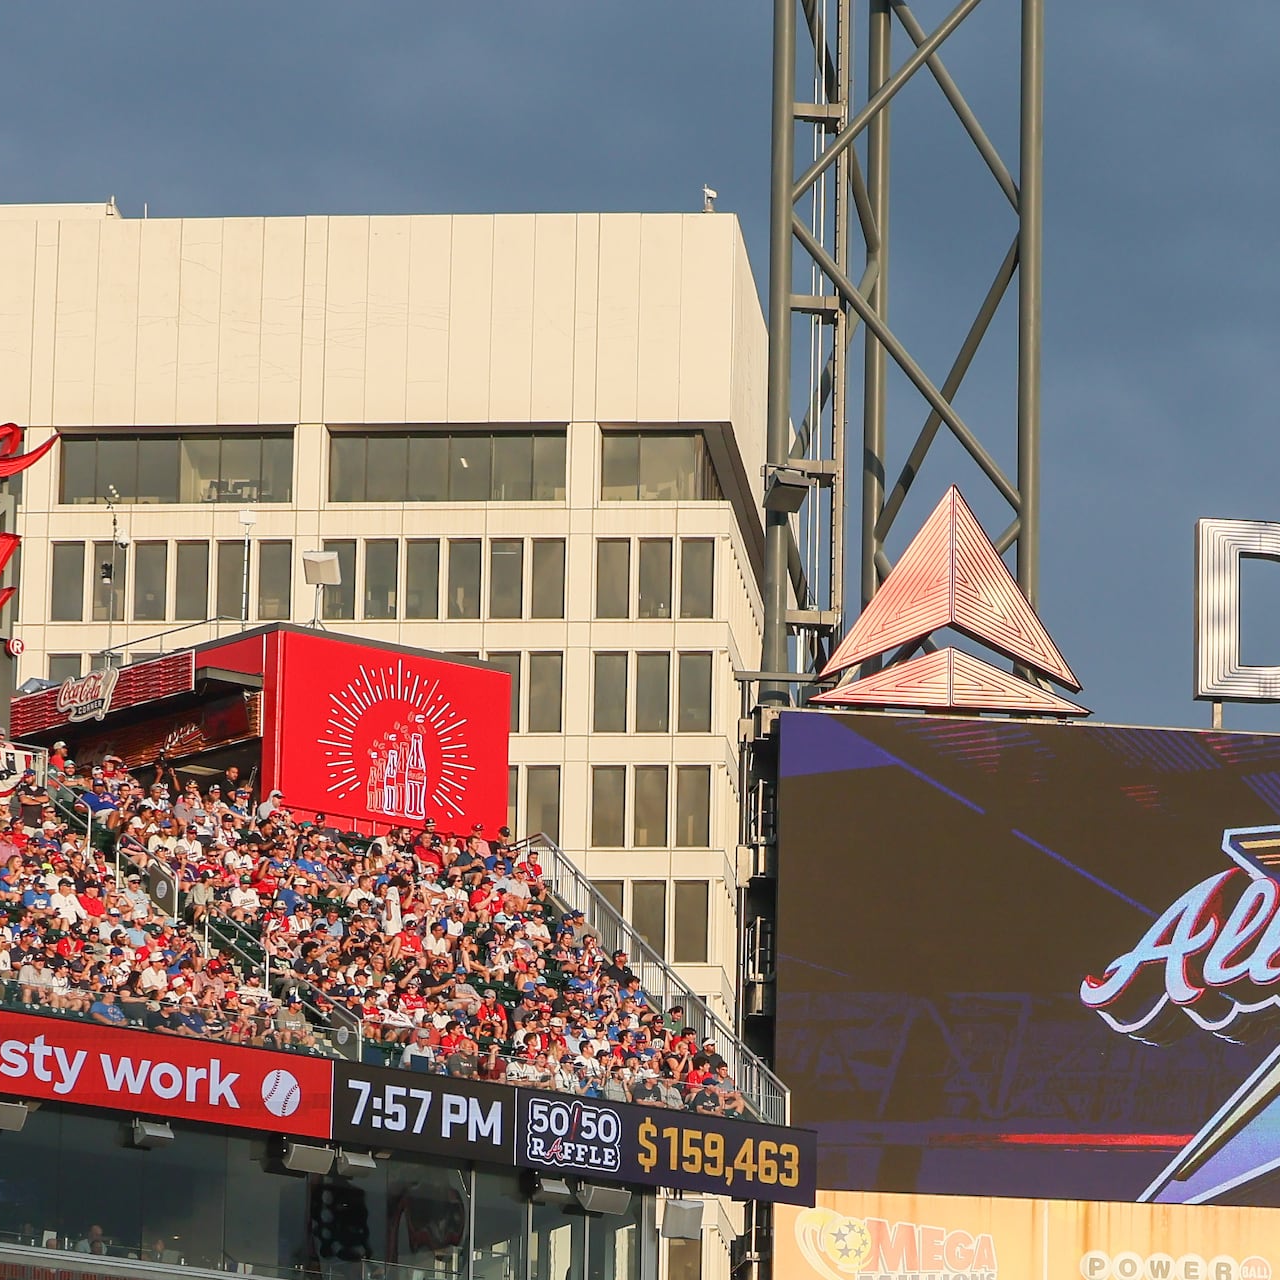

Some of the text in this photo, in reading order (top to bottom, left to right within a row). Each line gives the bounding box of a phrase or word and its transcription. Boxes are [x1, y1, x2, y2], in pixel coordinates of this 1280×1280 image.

[77, 699, 103, 715] CORNER
[100, 1053, 241, 1110] work
[348, 1080, 503, 1146] 7:57 PM
[531, 1102, 618, 1143] 50/50
[531, 1136, 616, 1168] RAFFLE
[637, 1117, 800, 1187] $159,463
[859, 1217, 997, 1273] MEGA
